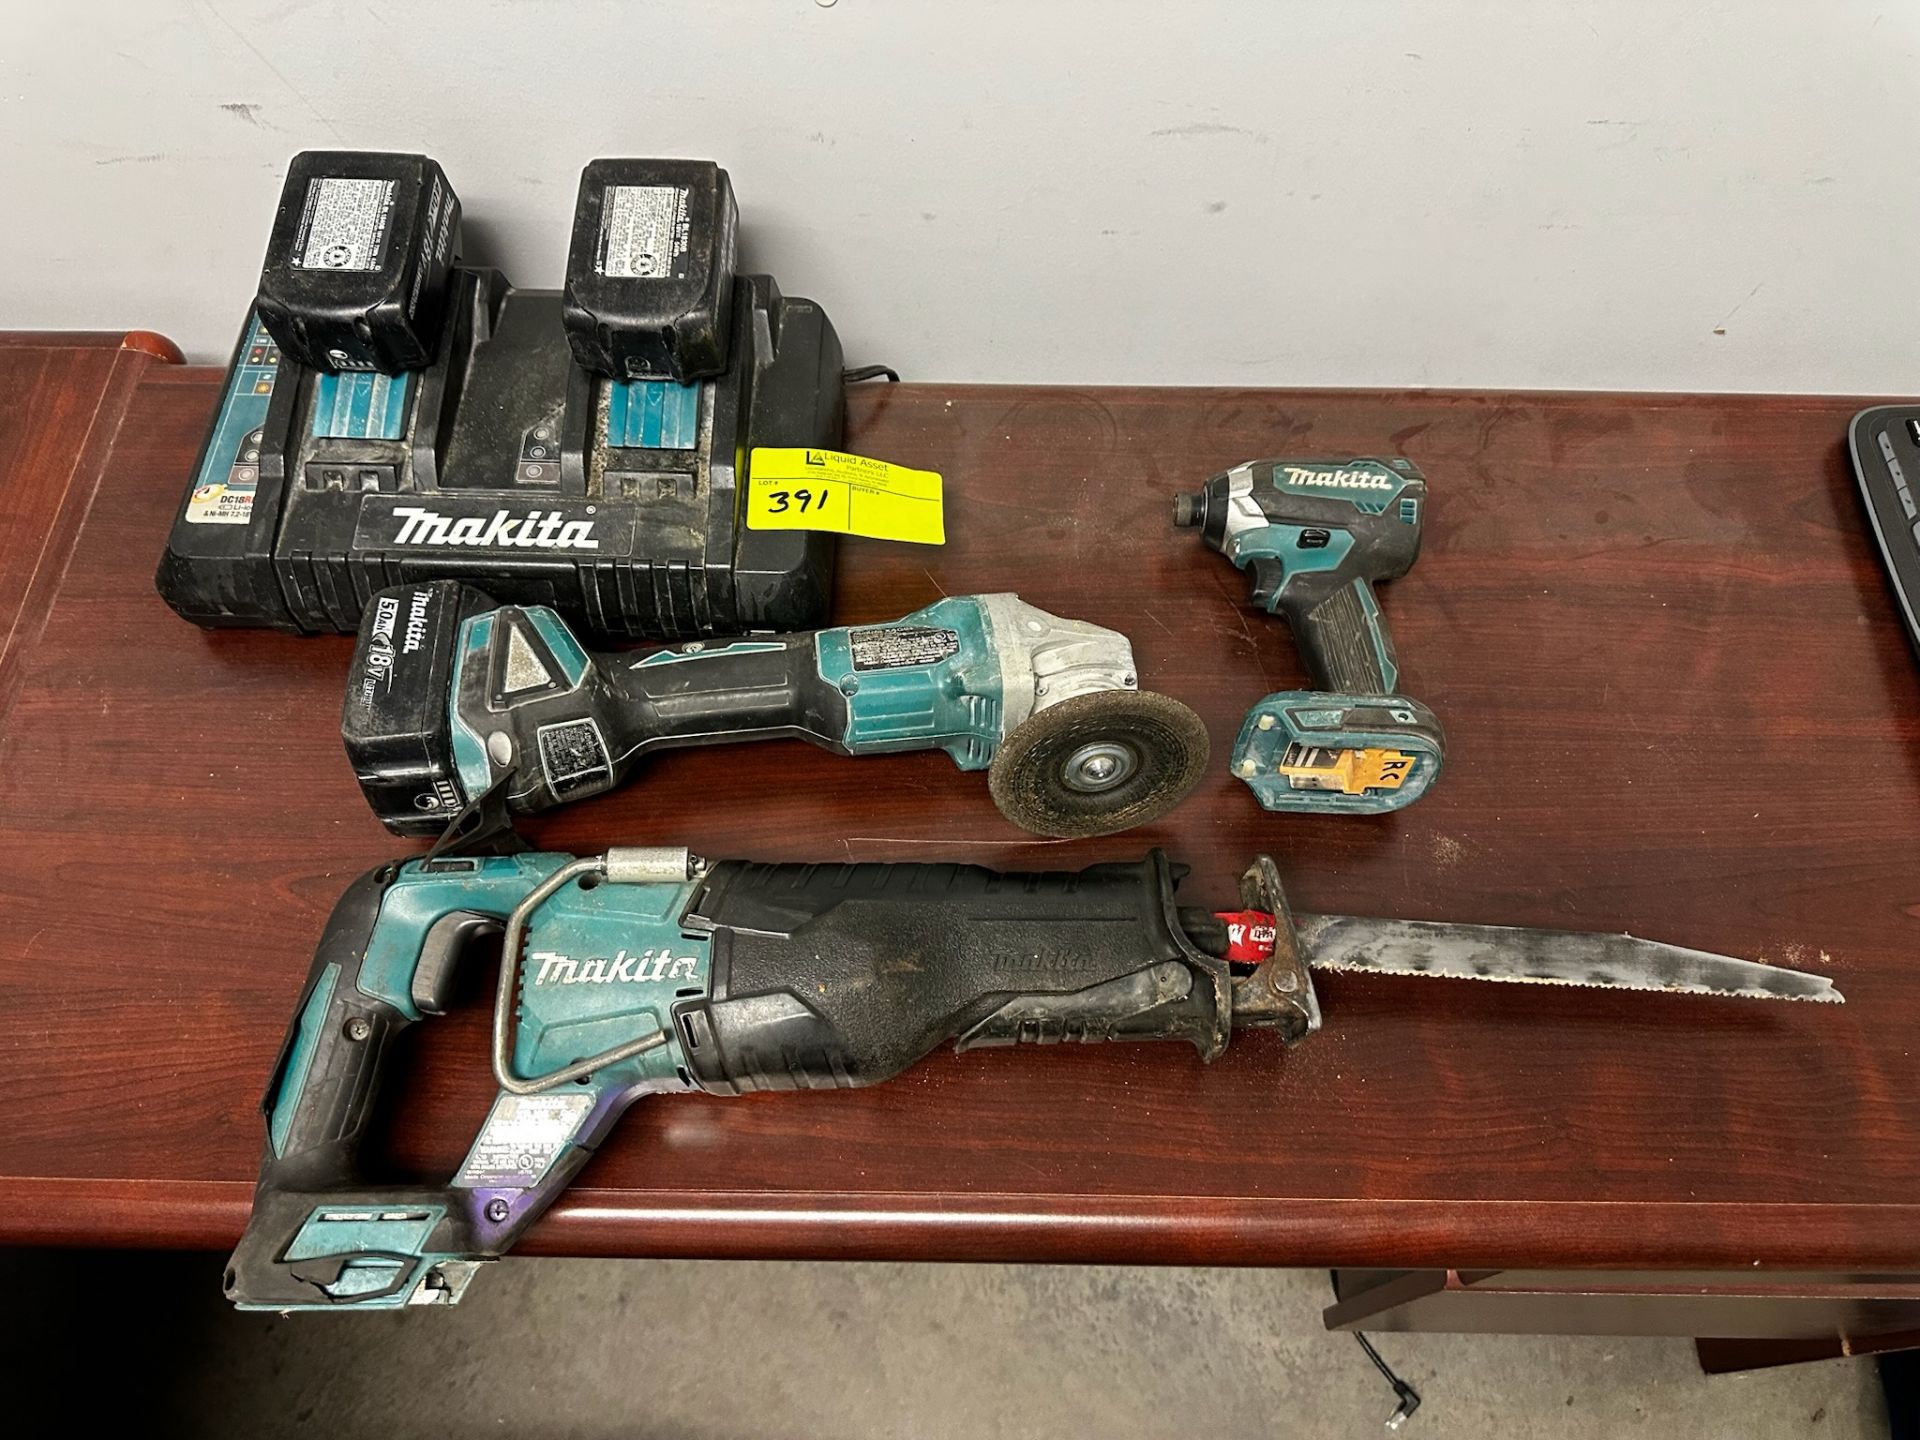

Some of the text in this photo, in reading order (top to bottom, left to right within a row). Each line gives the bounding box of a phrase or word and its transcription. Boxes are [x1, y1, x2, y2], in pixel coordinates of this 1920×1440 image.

[825, 452, 857, 465] Liquid
[860, 458, 889, 472] Asset
[1283, 467, 1393, 490] Makita
[220, 495, 254, 504] DC18R
[768, 489, 828, 514] 391
[392, 507, 600, 549] Makita
[402, 587, 434, 654] Makita
[365, 635, 397, 681] 18V
[531, 948, 700, 986] Makita
